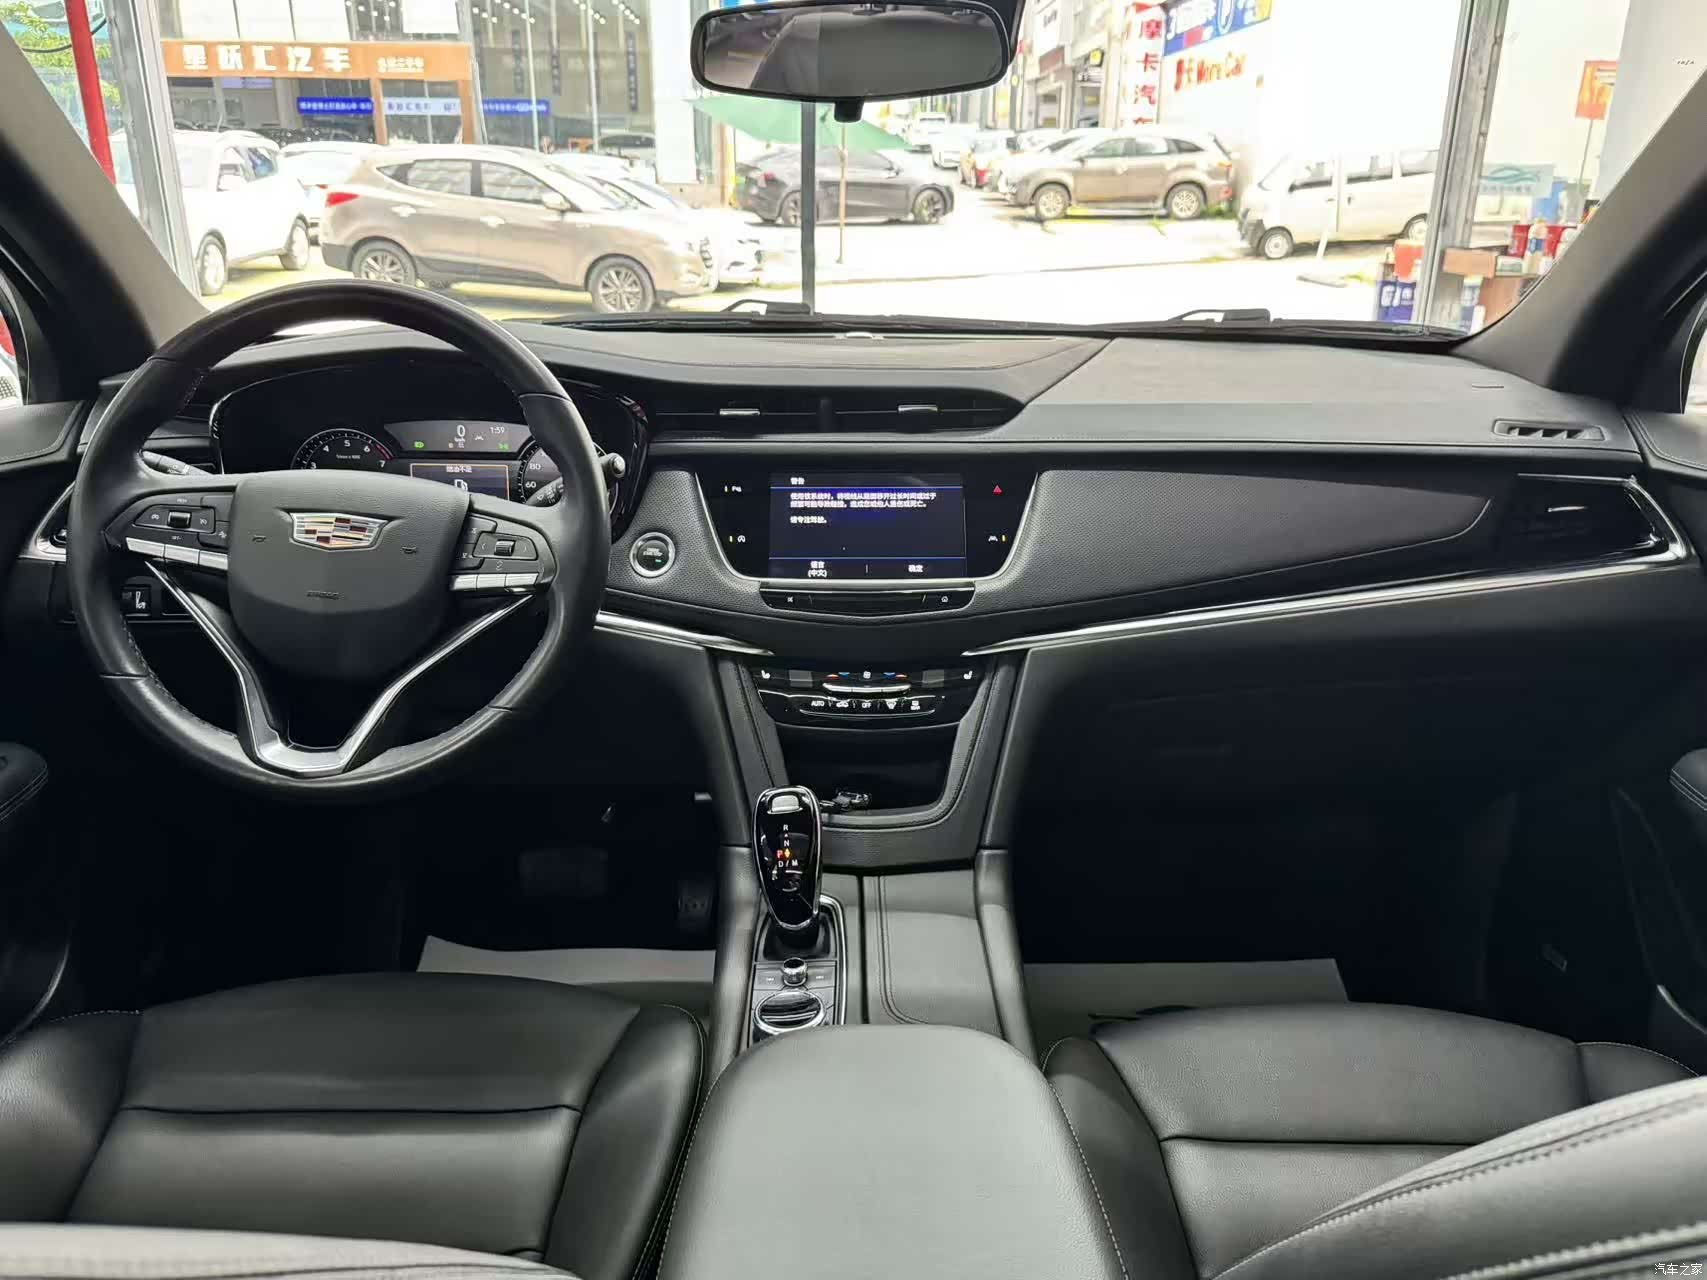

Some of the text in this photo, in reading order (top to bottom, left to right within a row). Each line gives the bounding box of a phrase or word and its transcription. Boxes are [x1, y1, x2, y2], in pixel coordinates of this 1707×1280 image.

[456, 424, 466, 437] 0
[490, 426, 505, 434] 1:59
[379, 460, 386, 468] 7
[790, 477, 805, 485] 警告
[808, 569, 828, 578] (中文)
[777, 850, 783, 858] P
